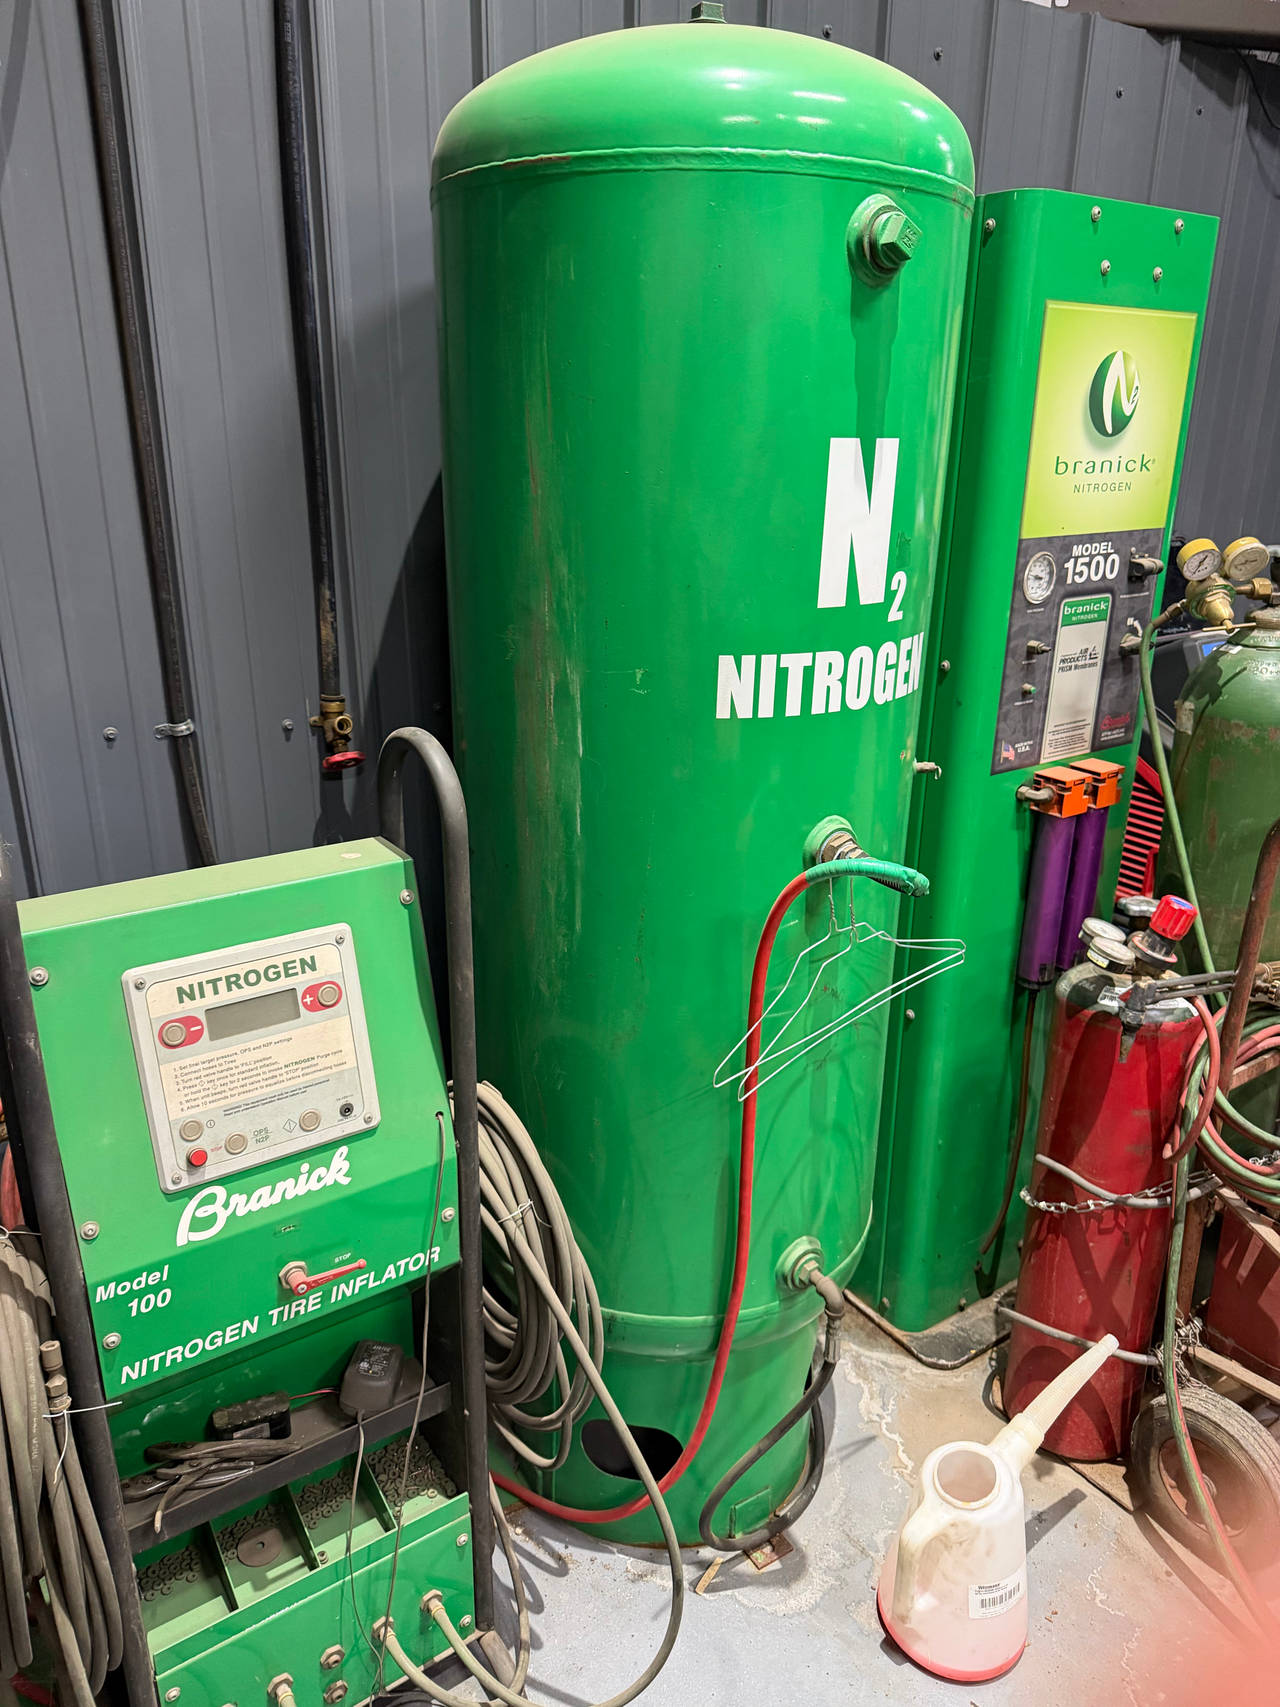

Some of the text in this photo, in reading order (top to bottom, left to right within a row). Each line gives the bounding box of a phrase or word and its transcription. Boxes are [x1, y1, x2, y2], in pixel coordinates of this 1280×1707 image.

[1073, 482, 1132, 494] NITROGEN
[1072, 542, 1115, 557] MODEL
[1063, 553, 1120, 585] 1500
[1064, 601, 1106, 615] branick
[1072, 613, 1098, 622] NITROGEN
[1058, 654, 1087, 665] PRODUCTS
[716, 632, 924, 719] NITROGEN
[1057, 664, 1073, 673] PRISM
[175, 955, 318, 1004] NITROGEN
[284, 1057, 316, 1069] NITROGEN
[252, 1127, 269, 1137] OPS
[255, 1135, 270, 1145] N2P
[176, 1146, 351, 1246] Branick
[334, 1253, 352, 1264] STOP
[95, 1264, 169, 1303] Model
[128, 1288, 172, 1317] 100
[120, 1246, 441, 1385] NITROGEN TIRE INFLATOR
